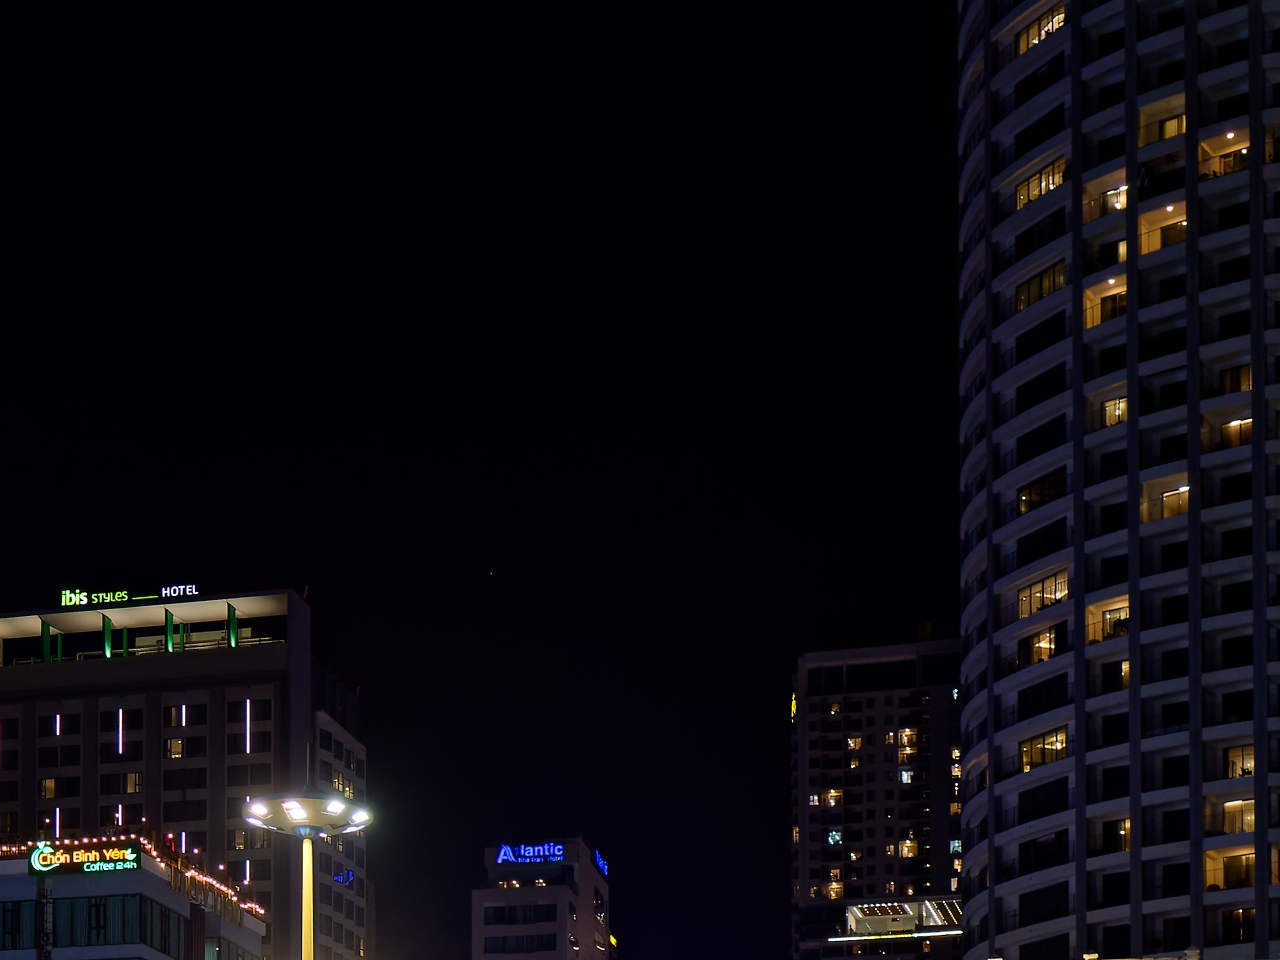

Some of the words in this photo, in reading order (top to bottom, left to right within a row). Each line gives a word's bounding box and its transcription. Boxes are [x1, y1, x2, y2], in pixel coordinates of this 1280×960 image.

[61, 589, 88, 606] ibis
[161, 585, 199, 597] HOTEL
[83, 862, 115, 871] Coffee
[116, 861, 137, 870] 24h
